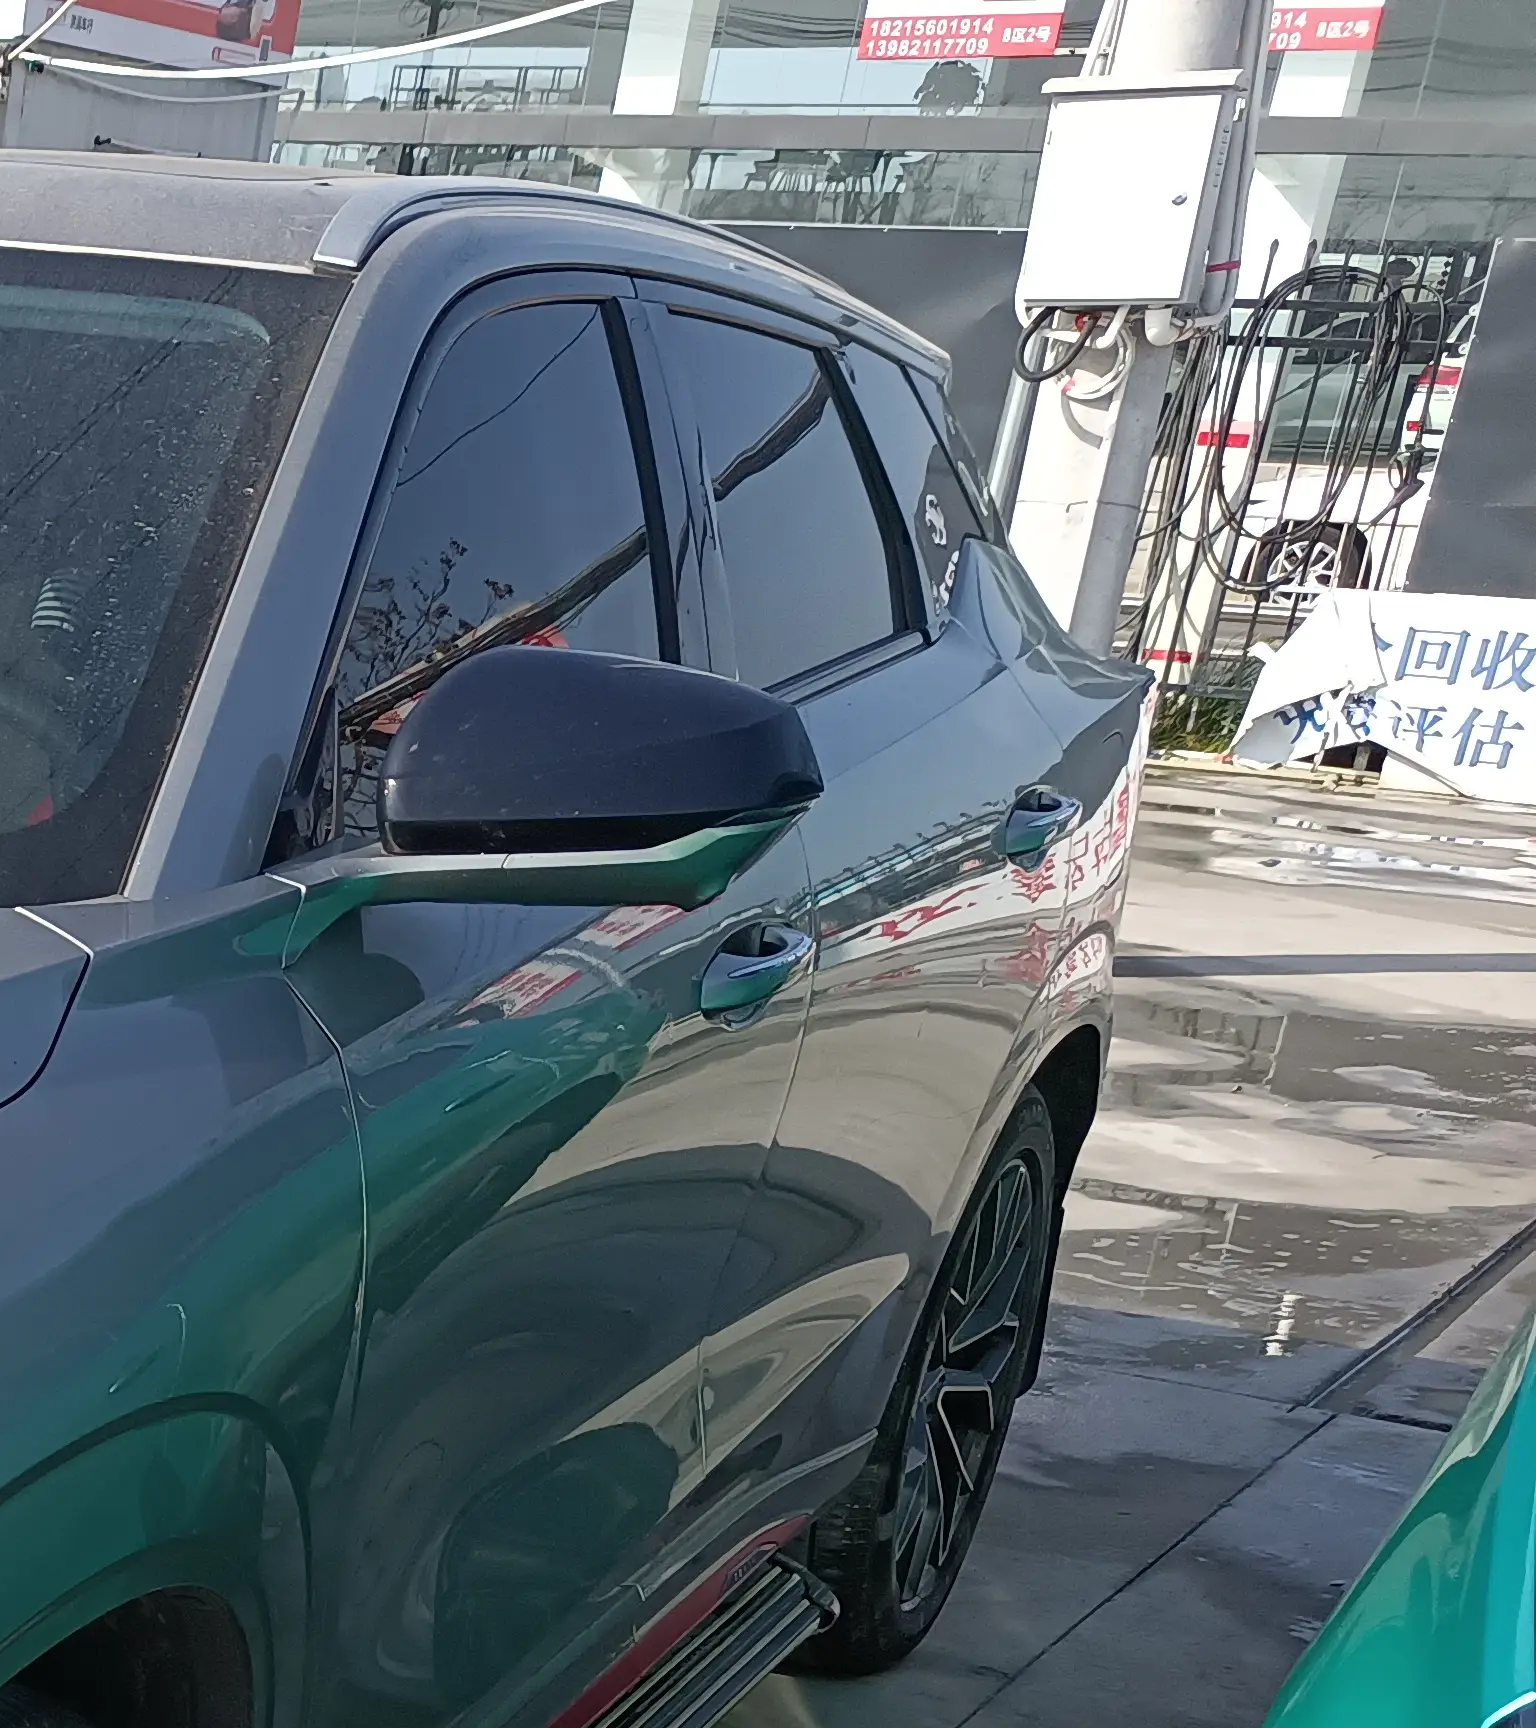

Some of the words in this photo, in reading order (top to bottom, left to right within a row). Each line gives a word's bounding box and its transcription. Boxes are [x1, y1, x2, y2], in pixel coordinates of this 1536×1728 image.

[870, 17, 995, 37] 18215601914
[866, 38, 989, 57] 13982117709
[1371, 623, 1536, 693] 回收
